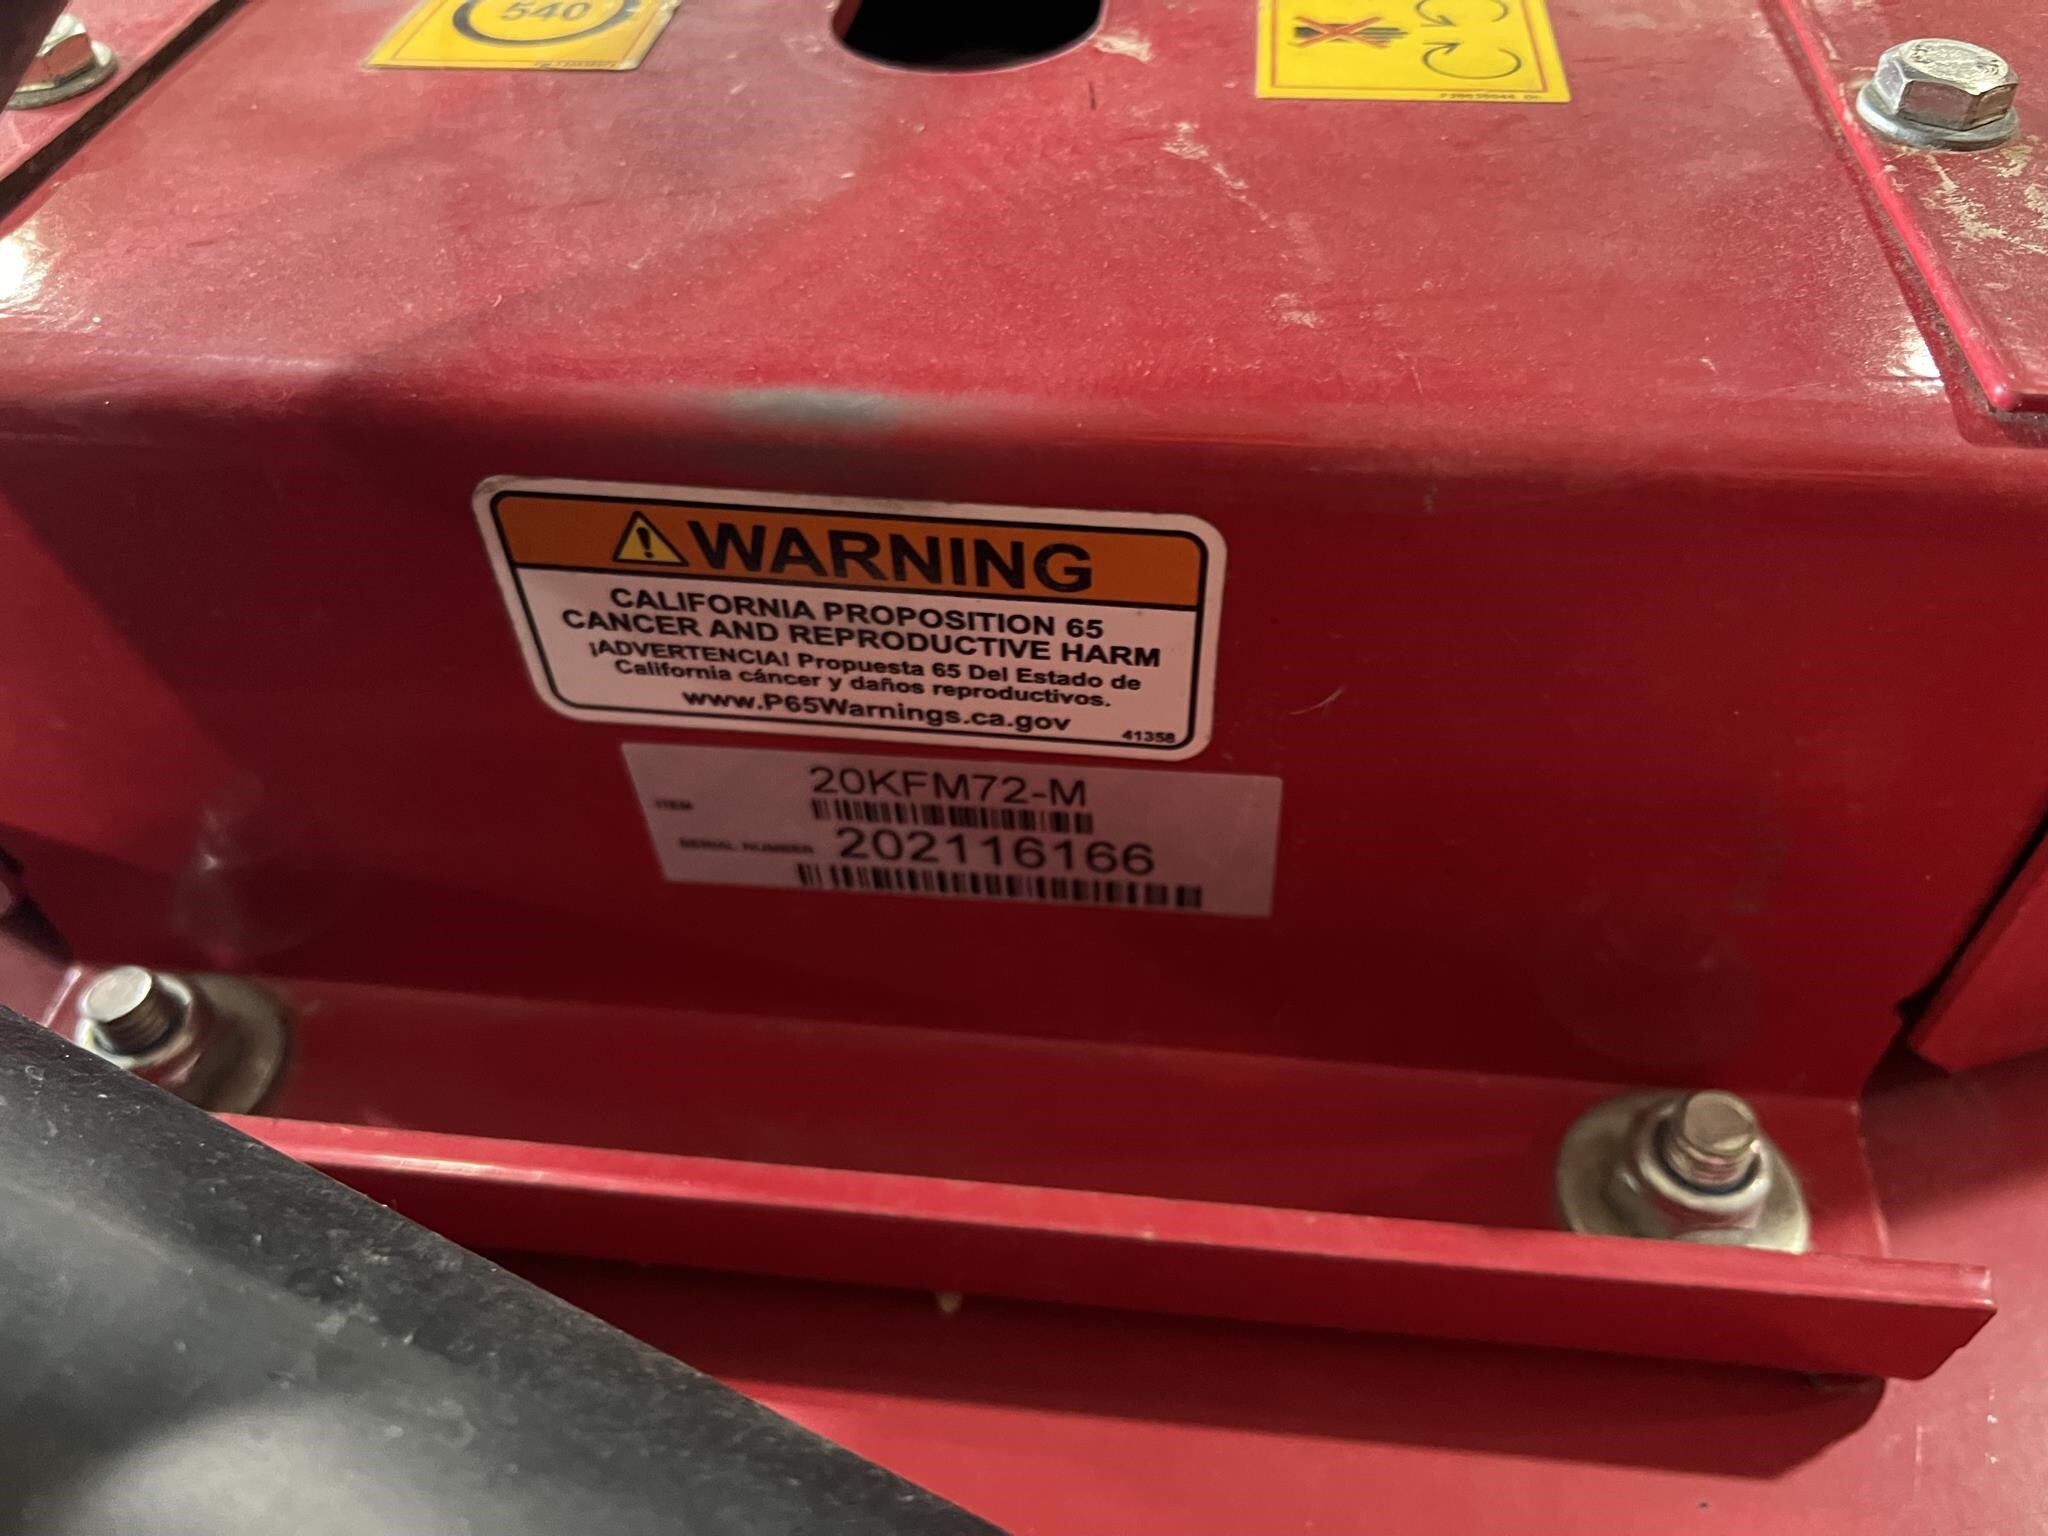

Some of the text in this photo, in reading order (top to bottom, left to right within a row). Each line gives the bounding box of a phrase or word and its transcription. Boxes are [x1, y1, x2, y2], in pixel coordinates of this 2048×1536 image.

[500, 1, 591, 21] 540
[687, 519, 1093, 592] WARNING
[610, 587, 1104, 639] CALIFORNIA PROPOSITION 65
[562, 608, 1161, 668] CANCER AND REPRODUCTIVE HARM
[589, 640, 1142, 690] ¡ADVERTENCIA! Propuesta 65 Del Estado de
[615, 659, 1112, 707] California cáncer y daños reproductivos.
[681, 690, 1071, 733] www.P65Warnings.ca.gov
[1121, 729, 1176, 745] 41358
[810, 766, 1087, 807] 20KFM72-M
[837, 826, 1156, 876] 202116166
